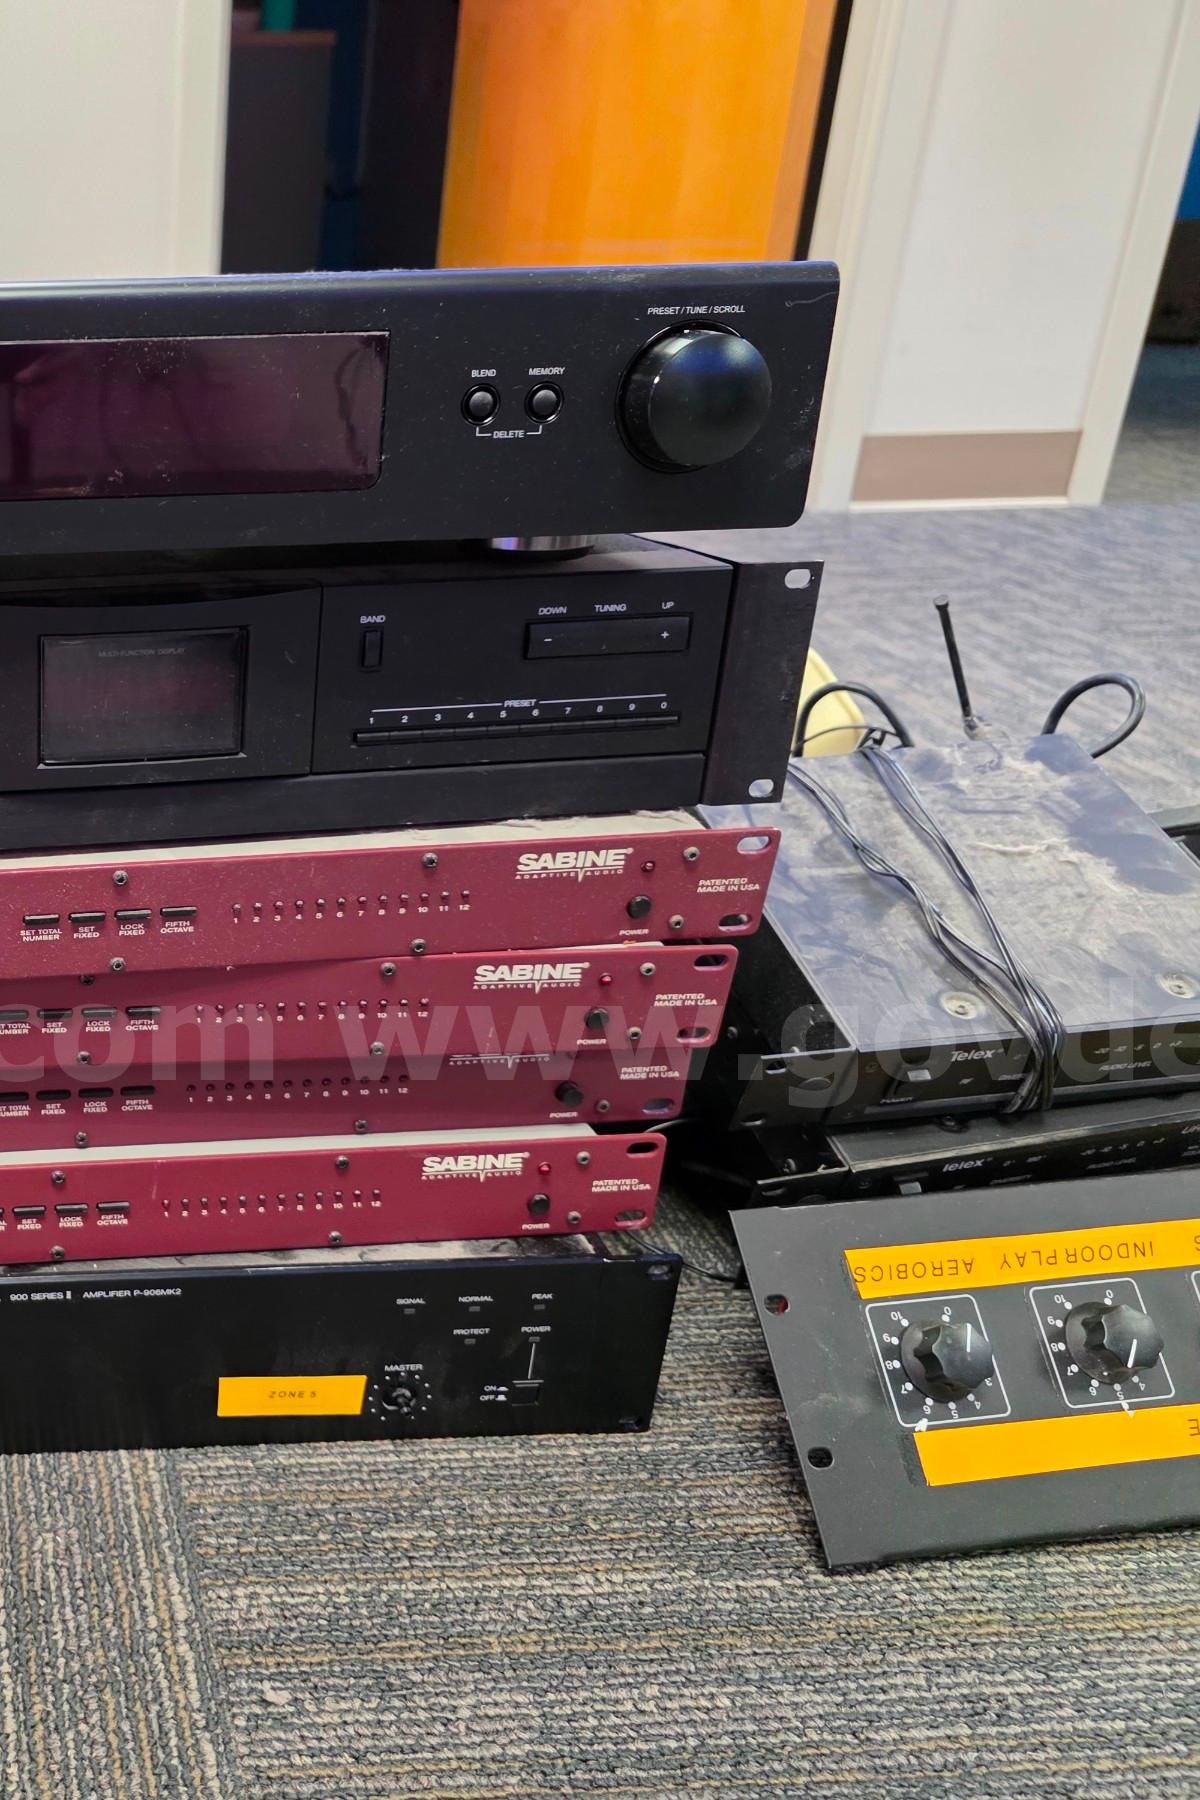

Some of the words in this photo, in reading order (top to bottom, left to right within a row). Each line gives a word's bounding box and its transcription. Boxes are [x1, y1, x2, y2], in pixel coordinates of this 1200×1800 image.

[647, 307, 680, 315] PRESET
[686, 306, 708, 315] TUNE
[713, 305, 746, 314] SCROLL
[471, 369, 497, 378] BLEND
[528, 367, 565, 376] MEMORY
[493, 430, 525, 439] DELETE
[594, 603, 627, 613] TUNING
[662, 601, 675, 610] UP
[538, 606, 567, 616] DOWN
[360, 614, 386, 624] BAND
[504, 699, 537, 708] PRESET
[515, 872, 576, 880] ADAPTIVE
[586, 868, 624, 877] AUDIO
[698, 878, 748, 887] PATENTED
[697, 885, 726, 893] MADE
[739, 883, 760, 891] USA
[160, 926, 194, 934] OCTAVE
[22, 934, 60, 942] NUMBER
[951, 1049, 995, 1062] Telex
[853, 1257, 975, 1283] AEROBICS
[10, 1293, 28, 1301] 900
[31, 1292, 63, 1300] SERIES
[83, 1289, 131, 1299] AMPLIFIER
[458, 1295, 493, 1303] NORMAL
[453, 1328, 490, 1336] PROTECT
[521, 1325, 551, 1333] POWER
[384, 1363, 423, 1373] MASTER
[269, 1390, 305, 1399] ZONE
